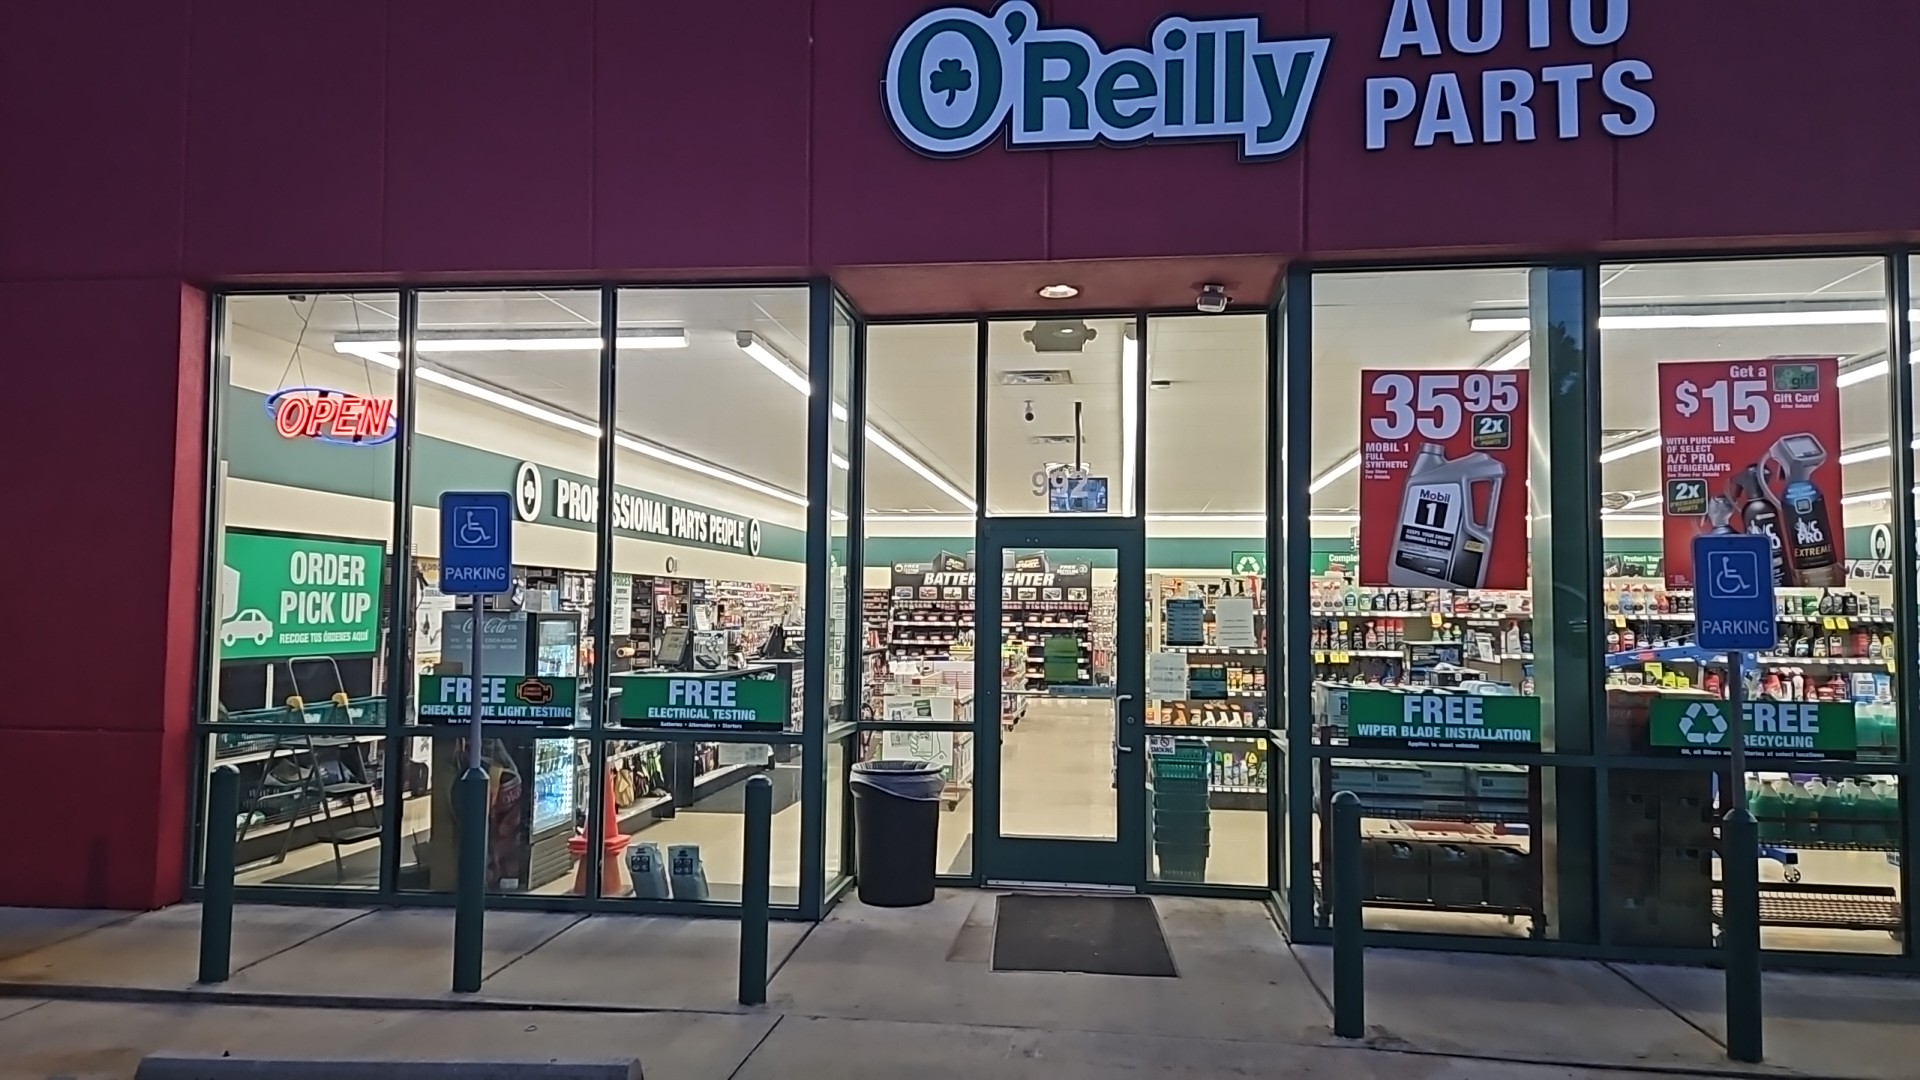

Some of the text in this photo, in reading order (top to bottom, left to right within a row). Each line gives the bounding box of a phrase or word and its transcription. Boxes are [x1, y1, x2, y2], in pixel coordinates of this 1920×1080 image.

[1379, 0, 1630, 58] AUTO
[888, 2, 1328, 154] O'Reilly
[1365, 60, 1656, 150] PARTS
[1730, 365, 1767, 378] Get a
[1773, 392, 1819, 403] Gift Card
[1675, 379, 1771, 433] $15
[277, 397, 392, 438] OPEN
[1479, 417, 1504, 435] 2x
[1666, 435, 1736, 445] WITH PURCHASE
[1365, 442, 1409, 453] MOBIL 1
[1666, 445, 1711, 453] OF SELECT
[1365, 453, 1385, 461] FULL
[1666, 453, 1715, 464] A/C PRO
[1365, 460, 1409, 469] SYNTHETIC
[1667, 463, 1731, 472] REFRIGERANTS
[1032, 470, 1088, 498] 992
[1675, 482, 1700, 500] 2x
[1419, 488, 1451, 503] Mobil
[556, 478, 669, 536] PROFSSIONAL
[671, 505, 707, 543] PARTS
[709, 515, 745, 548] PEOPLE
[1426, 502, 1438, 526] 1
[1796, 530, 1824, 544] PRO
[1794, 543, 1832, 557] EXTREME
[290, 551, 365, 586] ORDER
[445, 567, 506, 581] PARKING
[923, 572, 1055, 586] BATTER ENTER
[279, 591, 371, 625] PICK UP
[1702, 620, 1769, 635] PARKING
[279, 633, 310, 644] RECOGE
[310, 632, 323, 643] TUS
[669, 679, 737, 707] FREE
[420, 704, 572, 718] CHECK ENNE LIGHT TESTING
[648, 707, 756, 721] ELECTRICAL TESTING
[1403, 694, 1484, 725] FREE
[1357, 723, 1531, 742] WIPER BLADE INSTALLATION
[1150, 738, 1158, 746] NO
